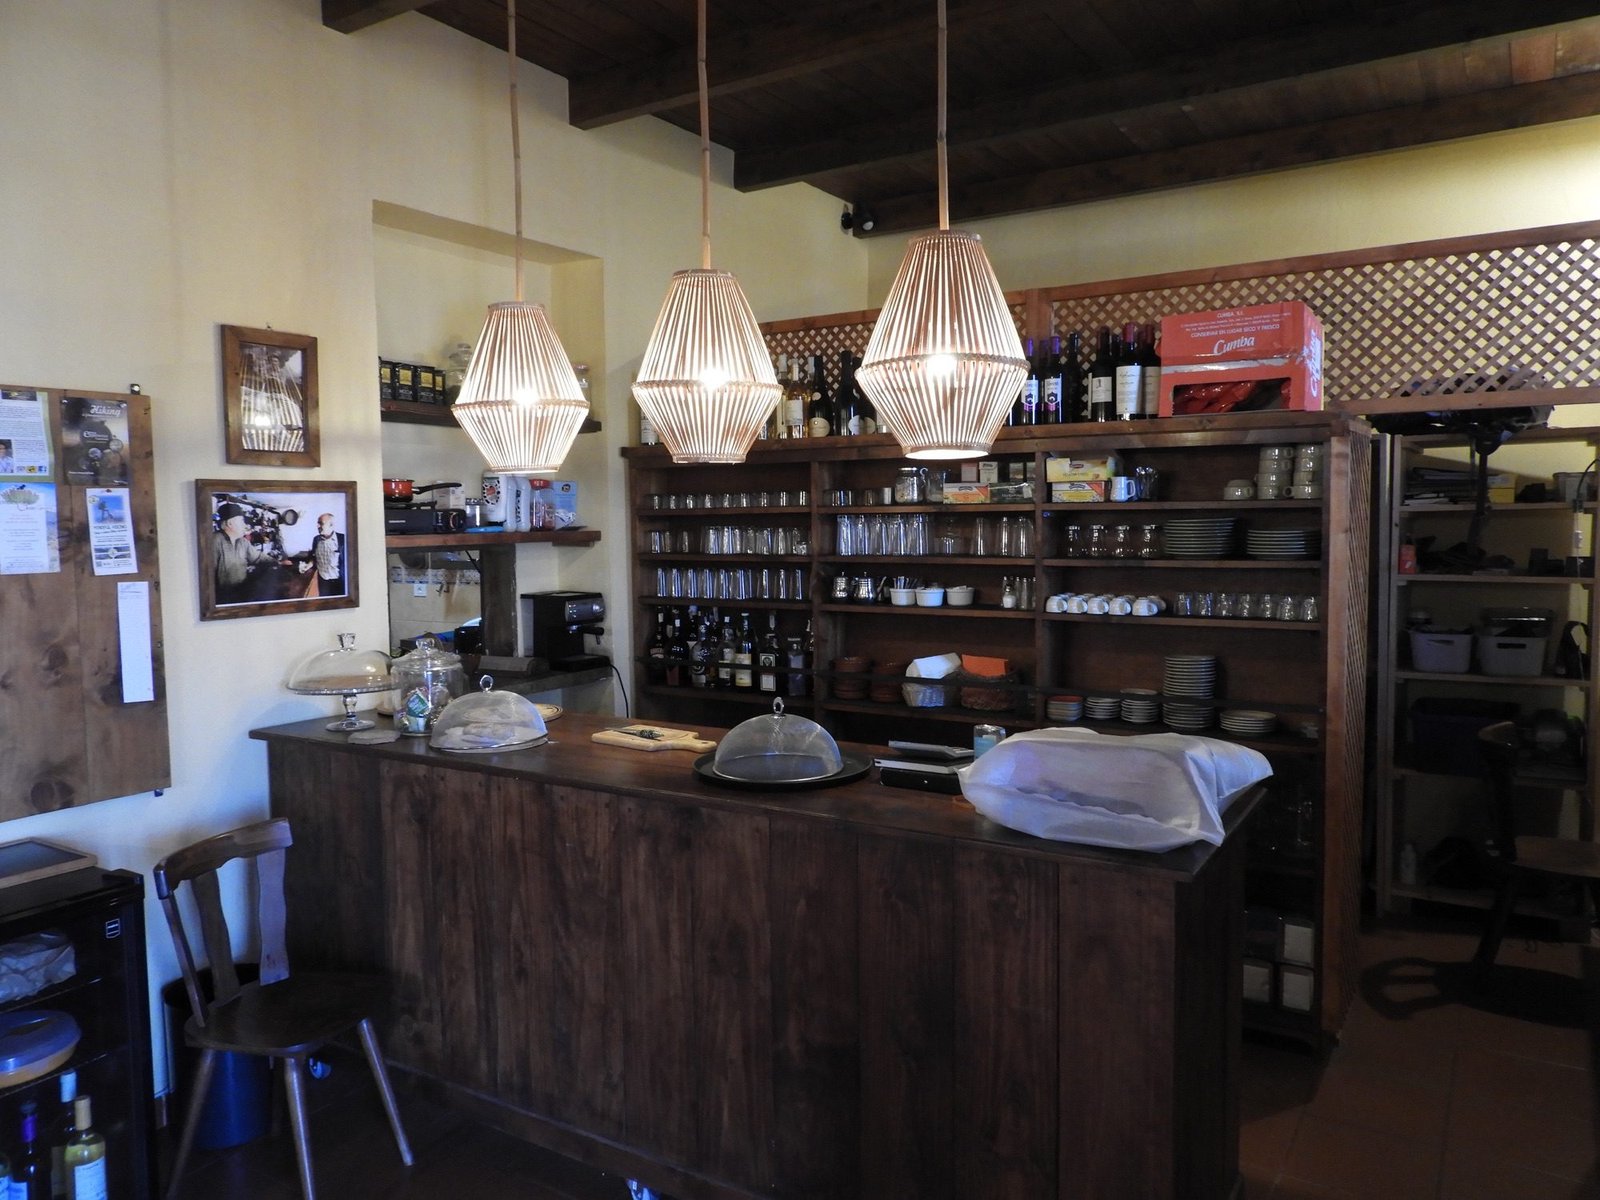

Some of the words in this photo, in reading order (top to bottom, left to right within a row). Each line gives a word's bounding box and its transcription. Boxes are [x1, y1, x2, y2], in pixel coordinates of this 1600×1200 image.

[1261, 323, 1280, 331] FRESCO
[1213, 336, 1255, 355] Cumba
[90, 404, 121, 416] Hiking
